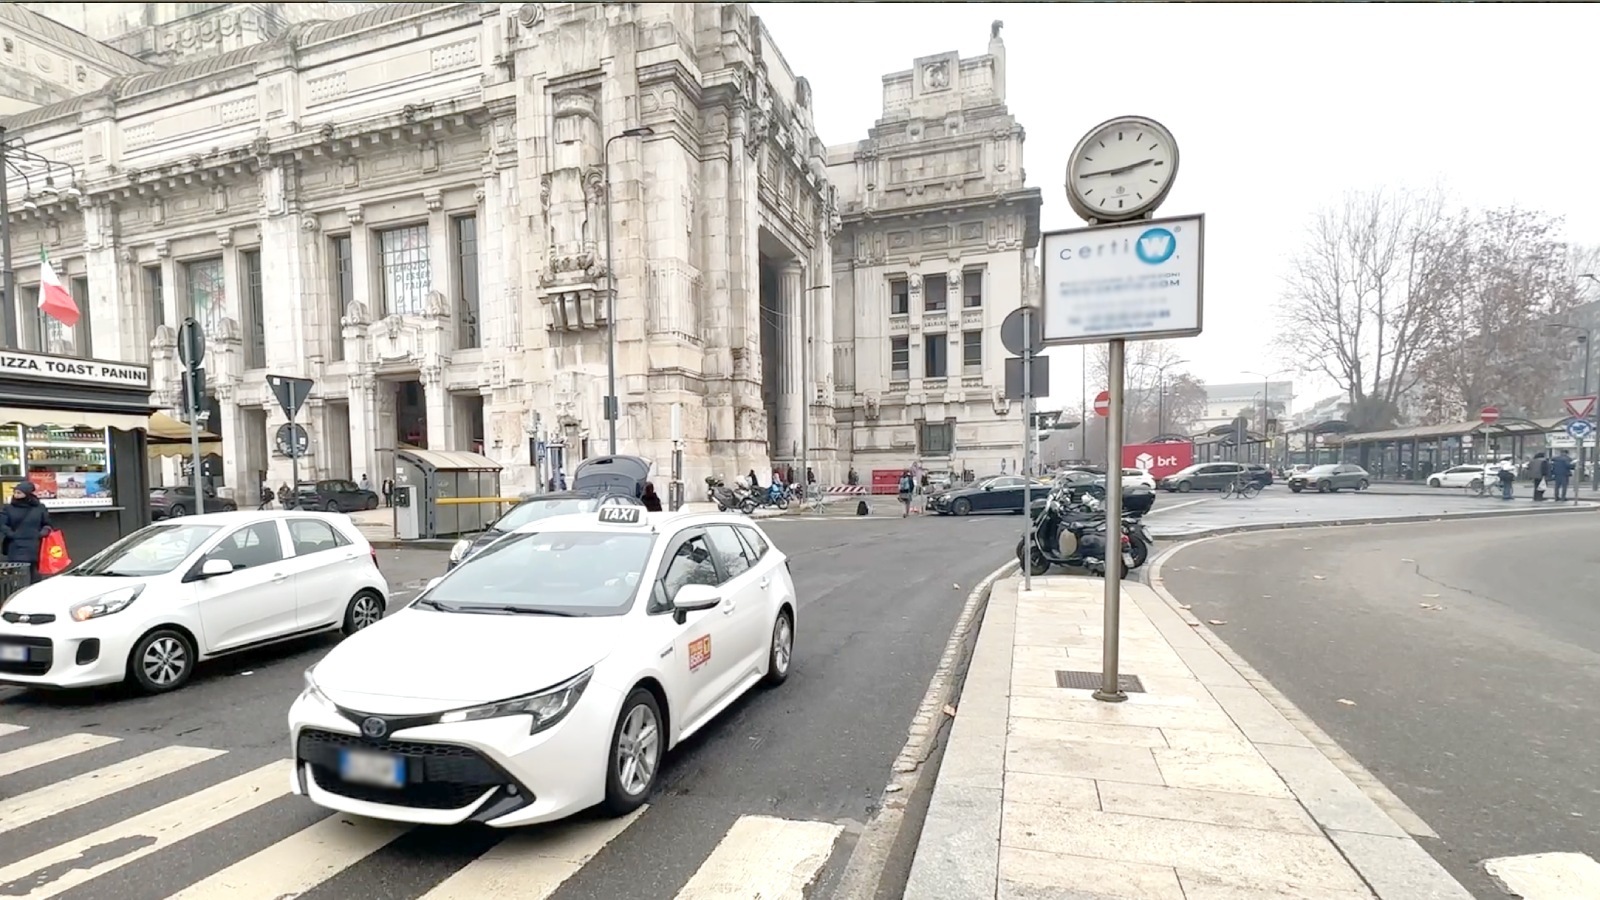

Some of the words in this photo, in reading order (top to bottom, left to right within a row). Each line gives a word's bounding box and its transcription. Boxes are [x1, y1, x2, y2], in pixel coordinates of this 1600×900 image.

[101, 367, 146, 381] PANINI
[1157, 455, 1178, 467] brt
[604, 508, 636, 522] TAXI
